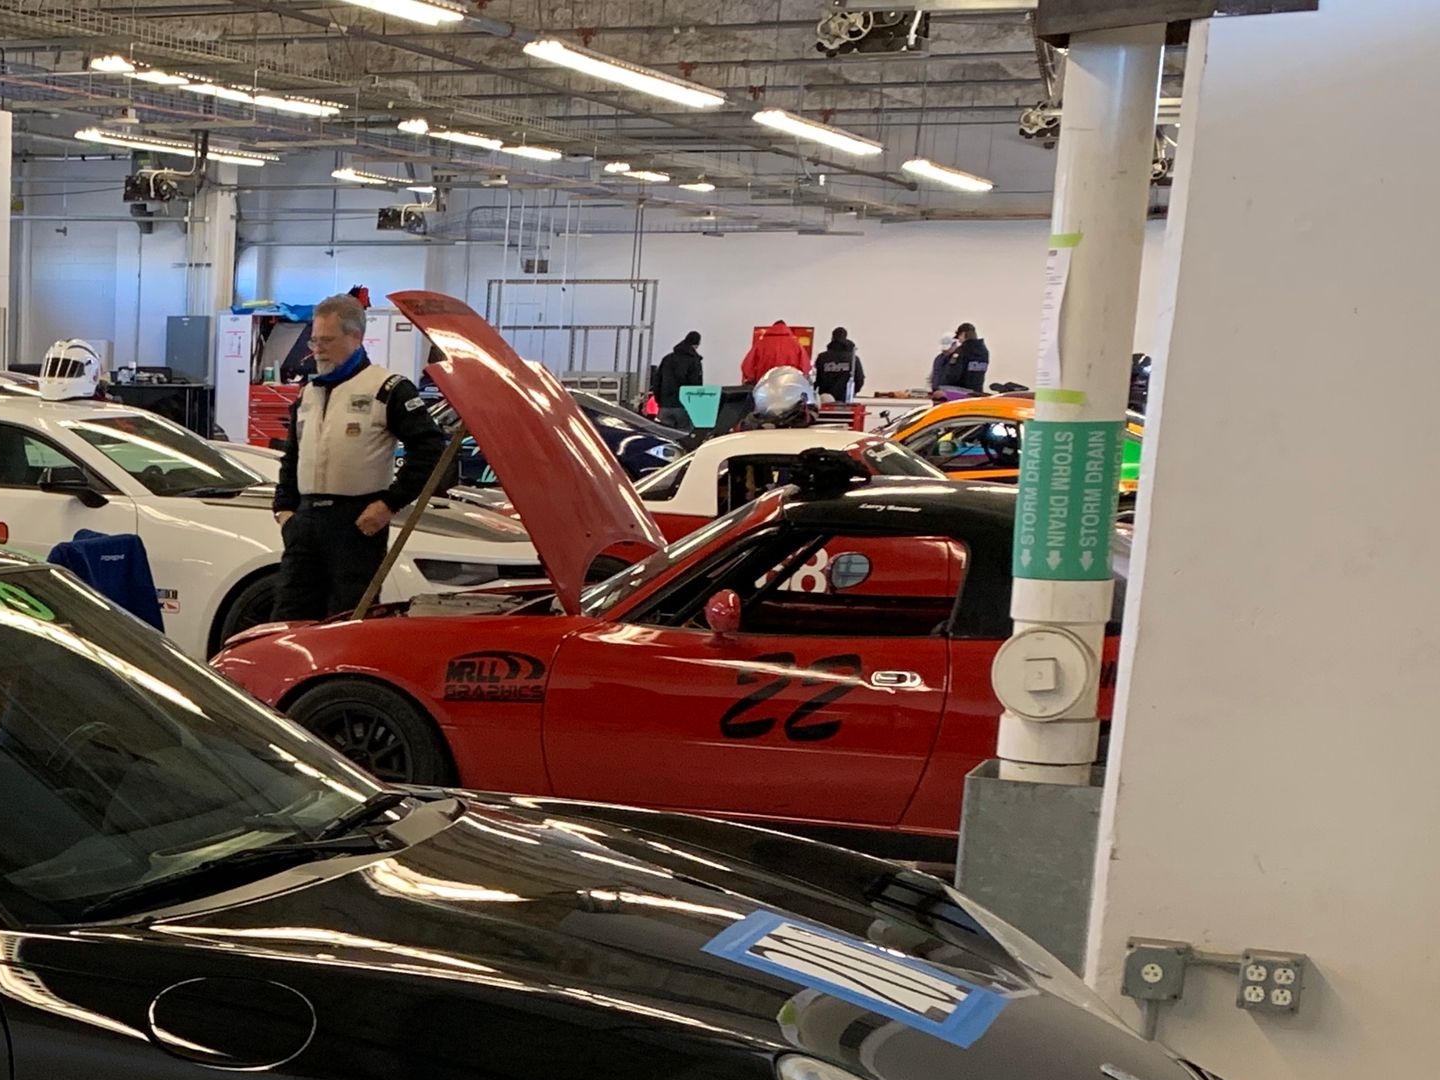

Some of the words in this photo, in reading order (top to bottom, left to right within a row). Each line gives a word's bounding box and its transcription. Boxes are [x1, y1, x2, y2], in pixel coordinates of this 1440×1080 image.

[1025, 430, 1043, 482] DRAIN
[1051, 431, 1074, 491] STORM
[1085, 431, 1106, 483] DRAIN
[1021, 487, 1038, 545] STORM
[1047, 496, 1069, 547] DRAIN
[1079, 488, 1103, 547] STORM
[720, 652, 862, 741] 22
